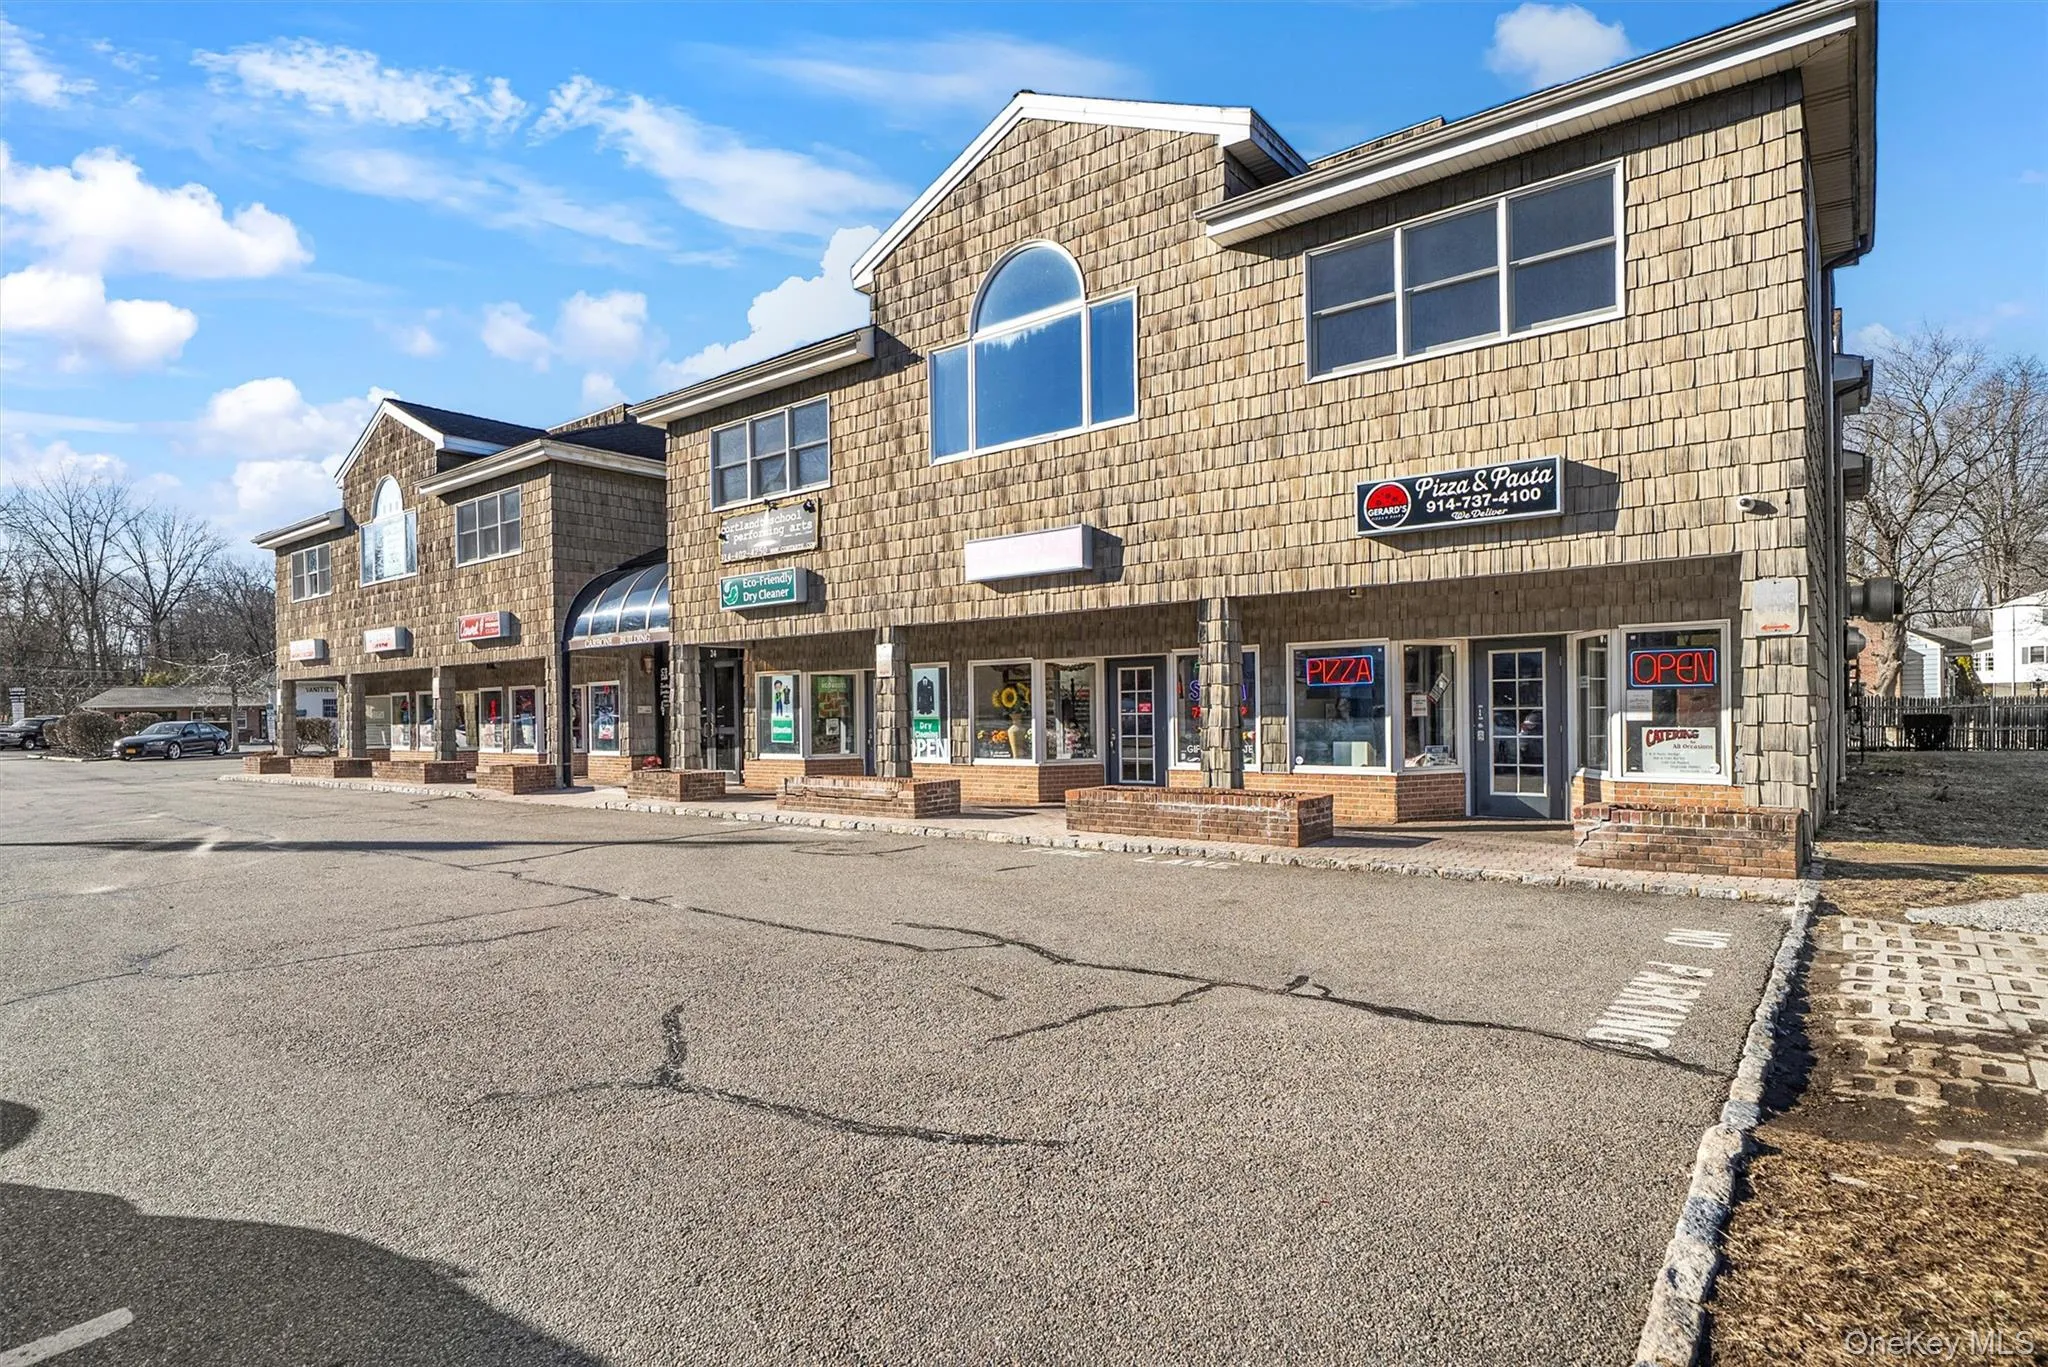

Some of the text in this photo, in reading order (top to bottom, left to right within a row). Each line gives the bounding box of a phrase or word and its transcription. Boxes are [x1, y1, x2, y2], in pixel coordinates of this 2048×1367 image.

[1415, 467, 1553, 499] Pizza & Pasta
[1426, 487, 1541, 513] 914-737-4100
[1368, 505, 1407, 517] GERARD'S
[1451, 507, 1508, 520] We Deliver
[789, 520, 813, 533] arts
[742, 572, 793, 588] Eco-Friendly
[743, 588, 789, 603] Dry Cleaner
[1308, 658, 1371, 683] PIZZA
[1634, 652, 1713, 684] OPEN
[920, 721, 932, 733] Dry
[1646, 729, 1699, 747] CATERING
[1585, 961, 1714, 1049] PARKING
